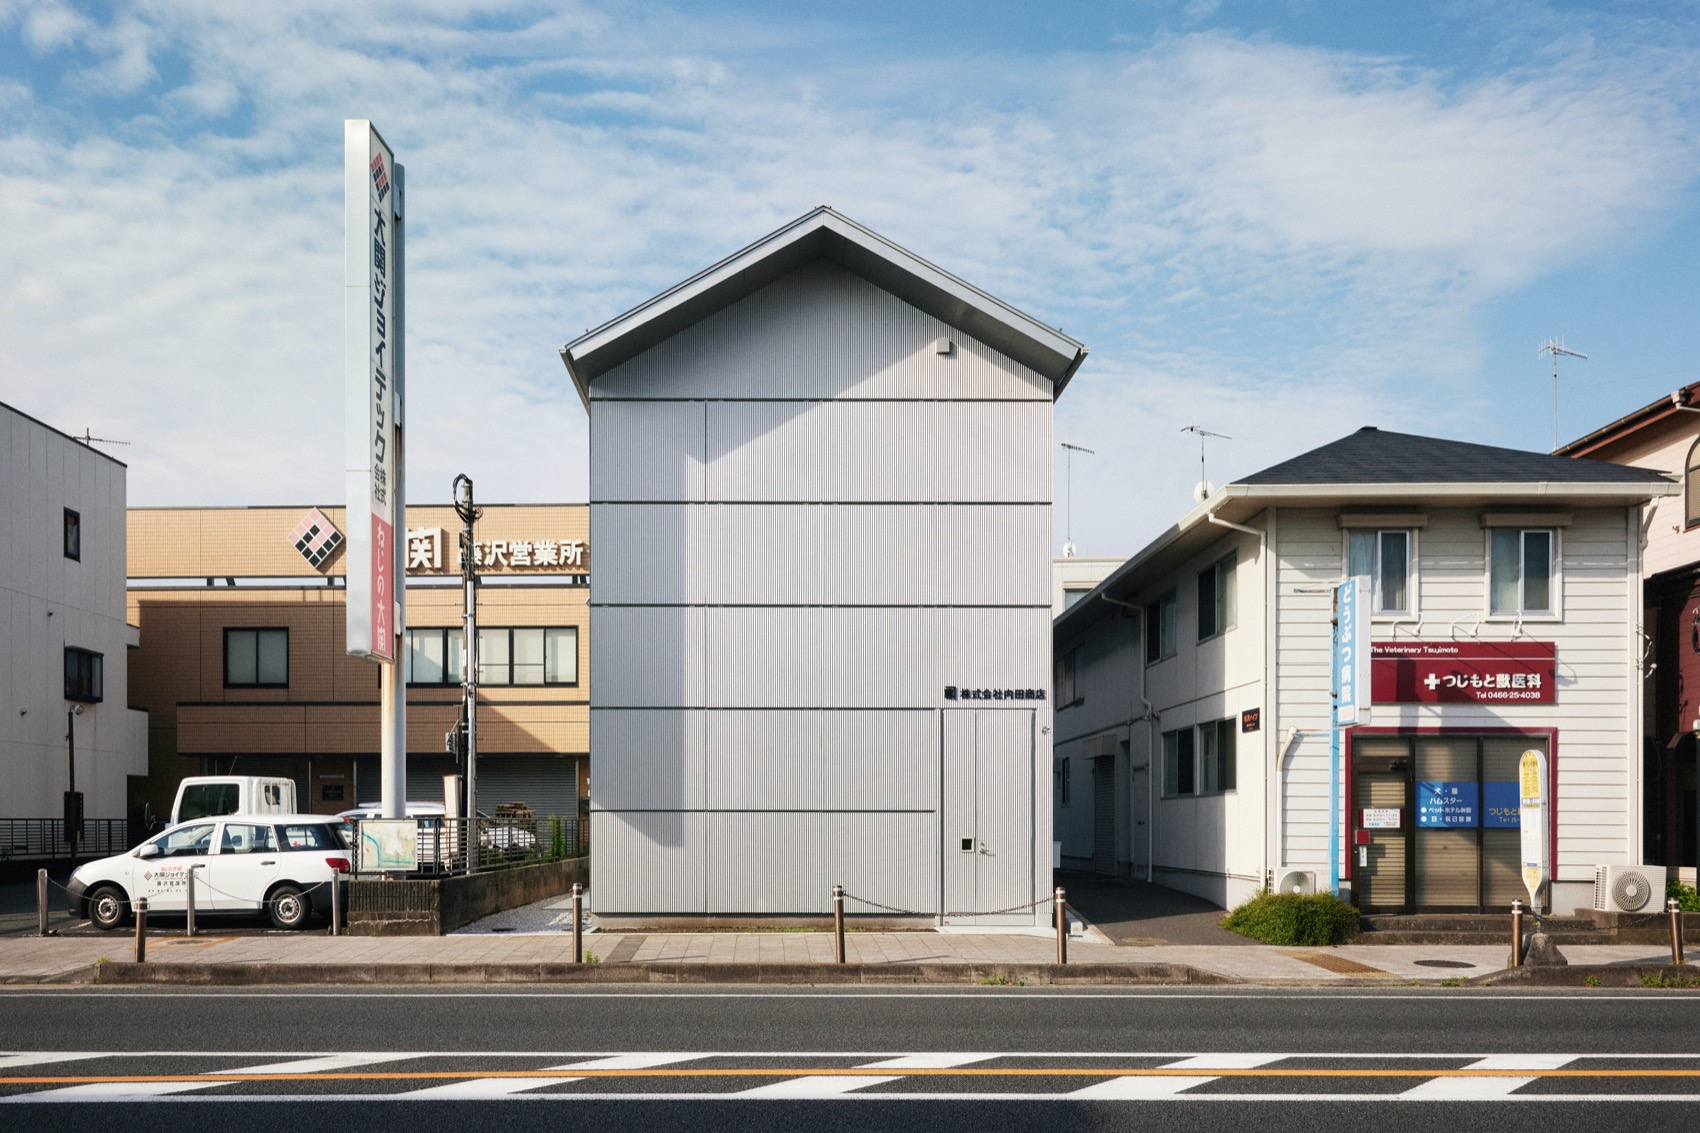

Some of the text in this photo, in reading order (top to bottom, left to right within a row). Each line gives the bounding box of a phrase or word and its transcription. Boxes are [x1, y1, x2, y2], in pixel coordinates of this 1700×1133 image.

[1341, 583, 1353, 704] どうぶつ病院
[1384, 646, 1422, 654] Veterinary
[1423, 646, 1459, 654] Tsujimoto
[1442, 673, 1541, 689] つじもと獣医科
[1476, 691, 1487, 699] Tel
[1429, 797, 1463, 805] ハムスター
[1488, 807, 1520, 816] つじもと
